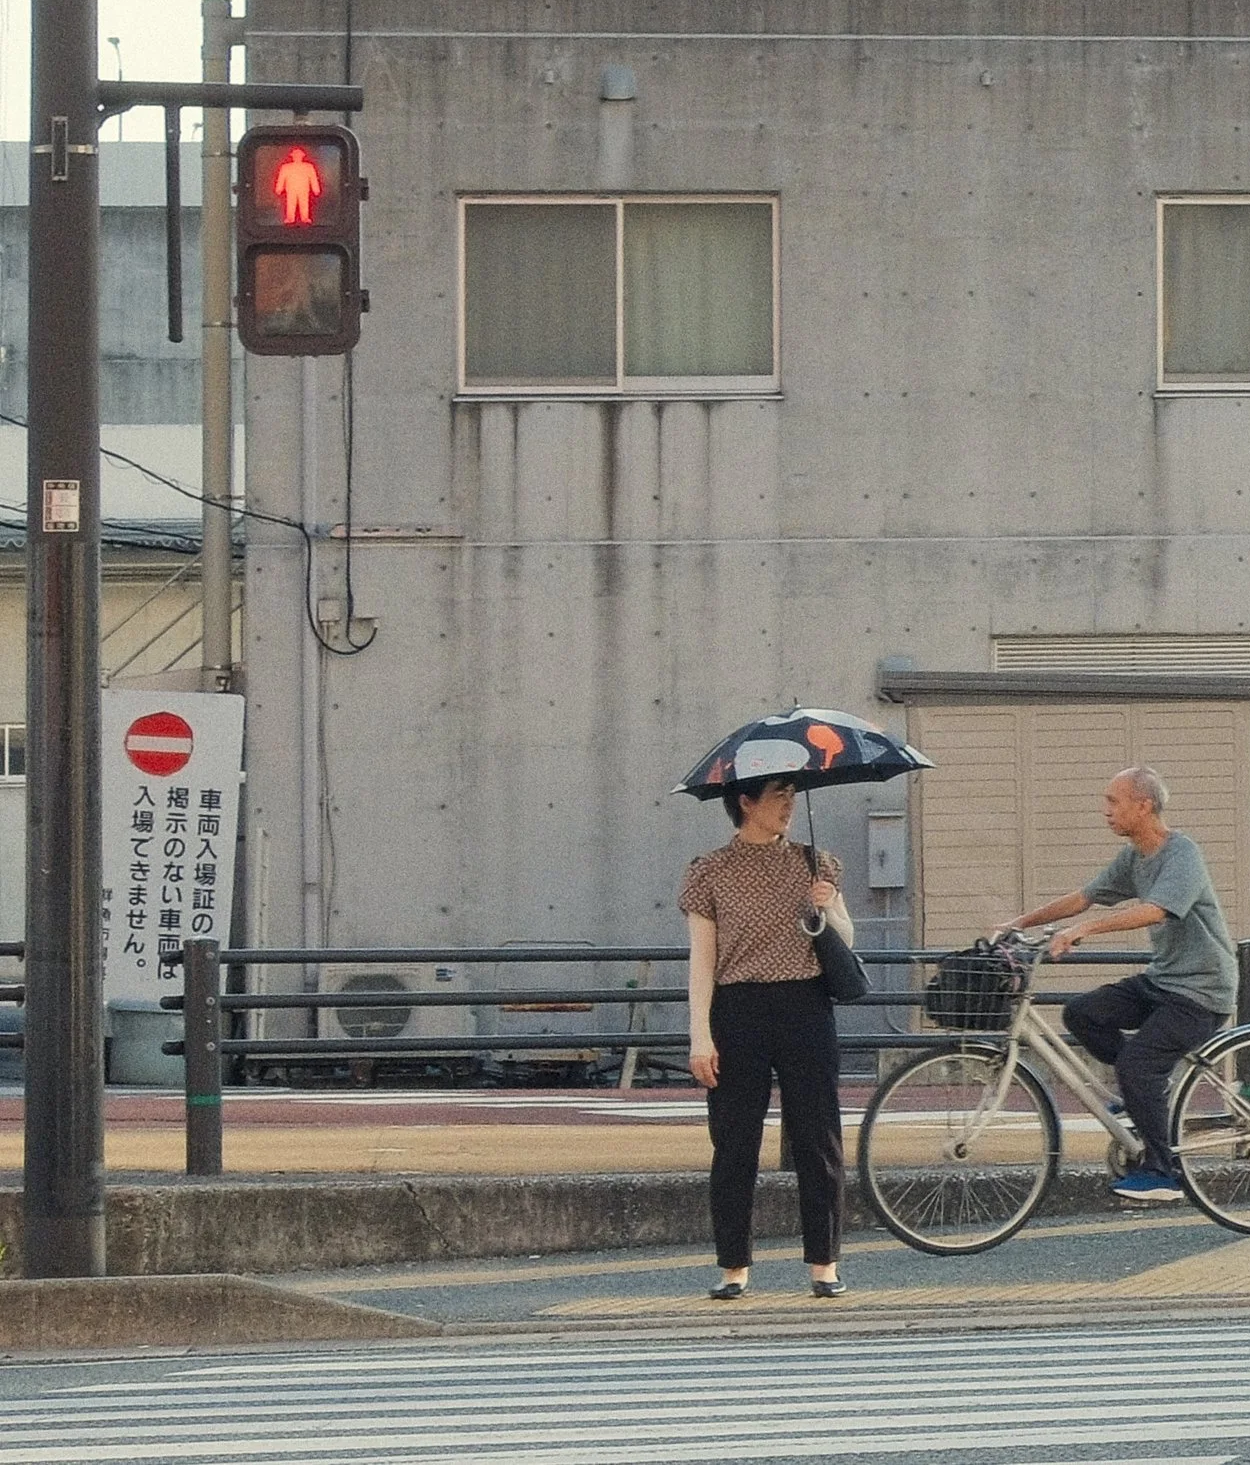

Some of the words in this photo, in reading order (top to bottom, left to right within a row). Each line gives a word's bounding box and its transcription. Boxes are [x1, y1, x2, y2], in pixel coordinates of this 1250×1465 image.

[123, 784, 155, 970] 入場できません。
[157, 785, 190, 980] 掲示のない車両は
[191, 788, 222, 934] 車両入場証の
